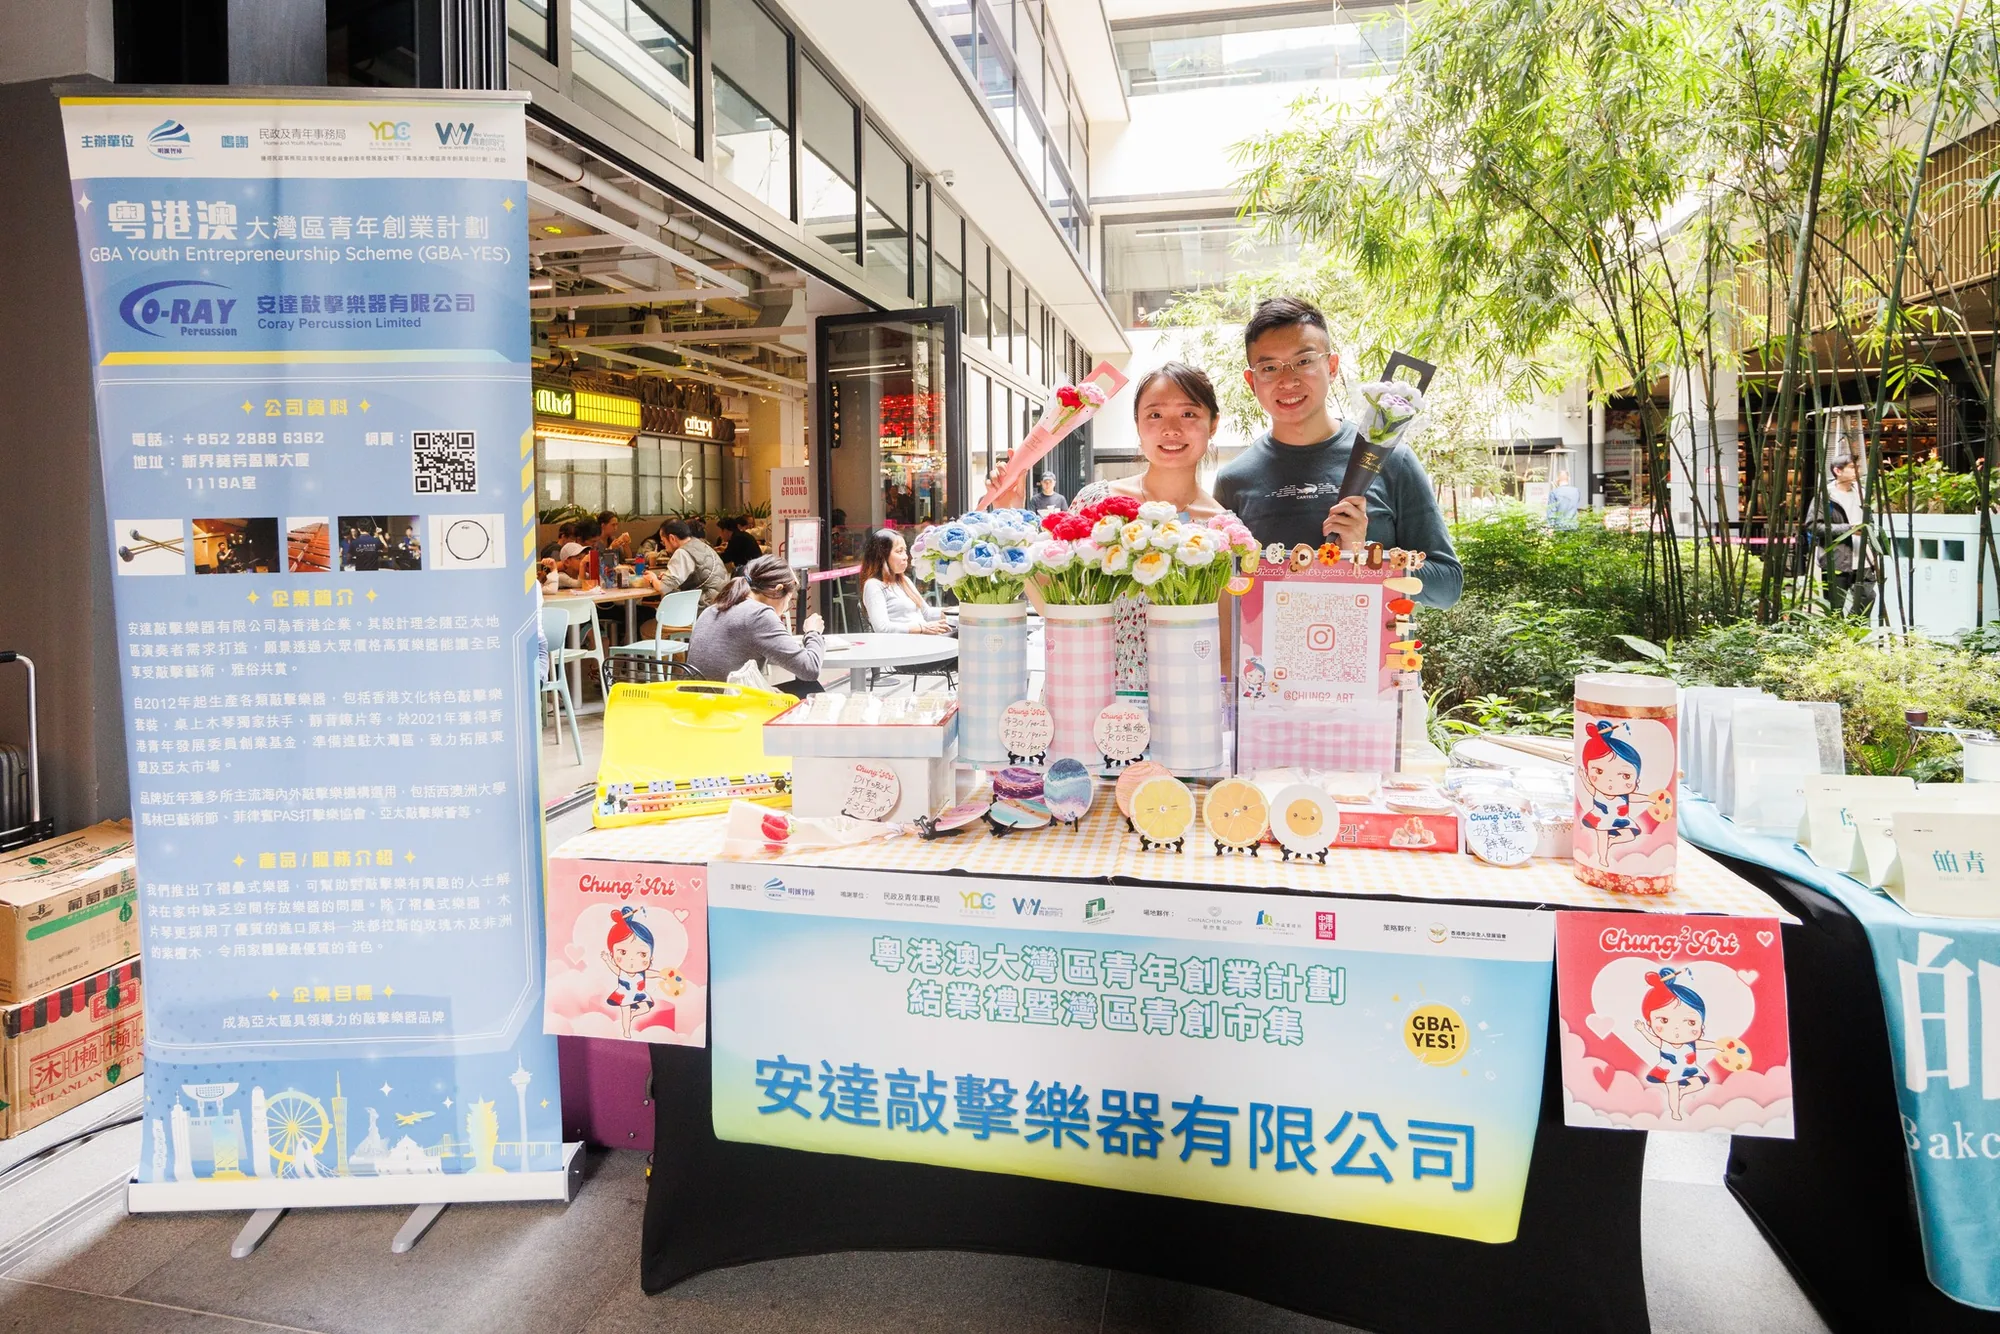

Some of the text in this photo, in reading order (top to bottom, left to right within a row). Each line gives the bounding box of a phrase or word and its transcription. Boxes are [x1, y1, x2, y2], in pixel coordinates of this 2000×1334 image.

[81, 135, 134, 148] 主辦單位
[259, 128, 346, 140] 民政及青年事務局
[107, 200, 490, 241] 粵港澳 大灣區青年創業計劃
[90, 246, 511, 265] GBA Youth Entrepreneurship Scheme (GBA-YES)
[257, 293, 476, 315] 安達敲擊樂器有限公司
[180, 325, 238, 337] Percussion
[257, 317, 421, 331] Coray Percussion Limited
[264, 398, 348, 417] 公司資料
[283, 431, 325, 444] 6362
[186, 476, 257, 490] 1119A室
[782, 476, 806, 486] DINING
[781, 486, 808, 496] GROUND
[1254, 566, 1285, 577] Thank
[1321, 568, 1345, 579] your
[272, 588, 354, 608] 企業簡介
[1108, 734, 1139, 742] ROSES
[639, 876, 676, 896] Art
[883, 892, 941, 904] 民政及青年事務局
[1187, 917, 1223, 925] CHINACHEM
[1685, 928, 1740, 956] Art
[869, 934, 1348, 1007] 粵港澳大灣區青年創業計劃
[292, 985, 373, 1003] 企業目標
[906, 978, 1306, 1048] 結業禮暨灣區青創市集
[1412, 1014, 1461, 1034] GBA-
[1411, 1030, 1458, 1051] YES!
[29, 1070, 103, 1111] MULANLAN
[754, 1053, 1477, 1193] 安達敲擊樂器有限公司
